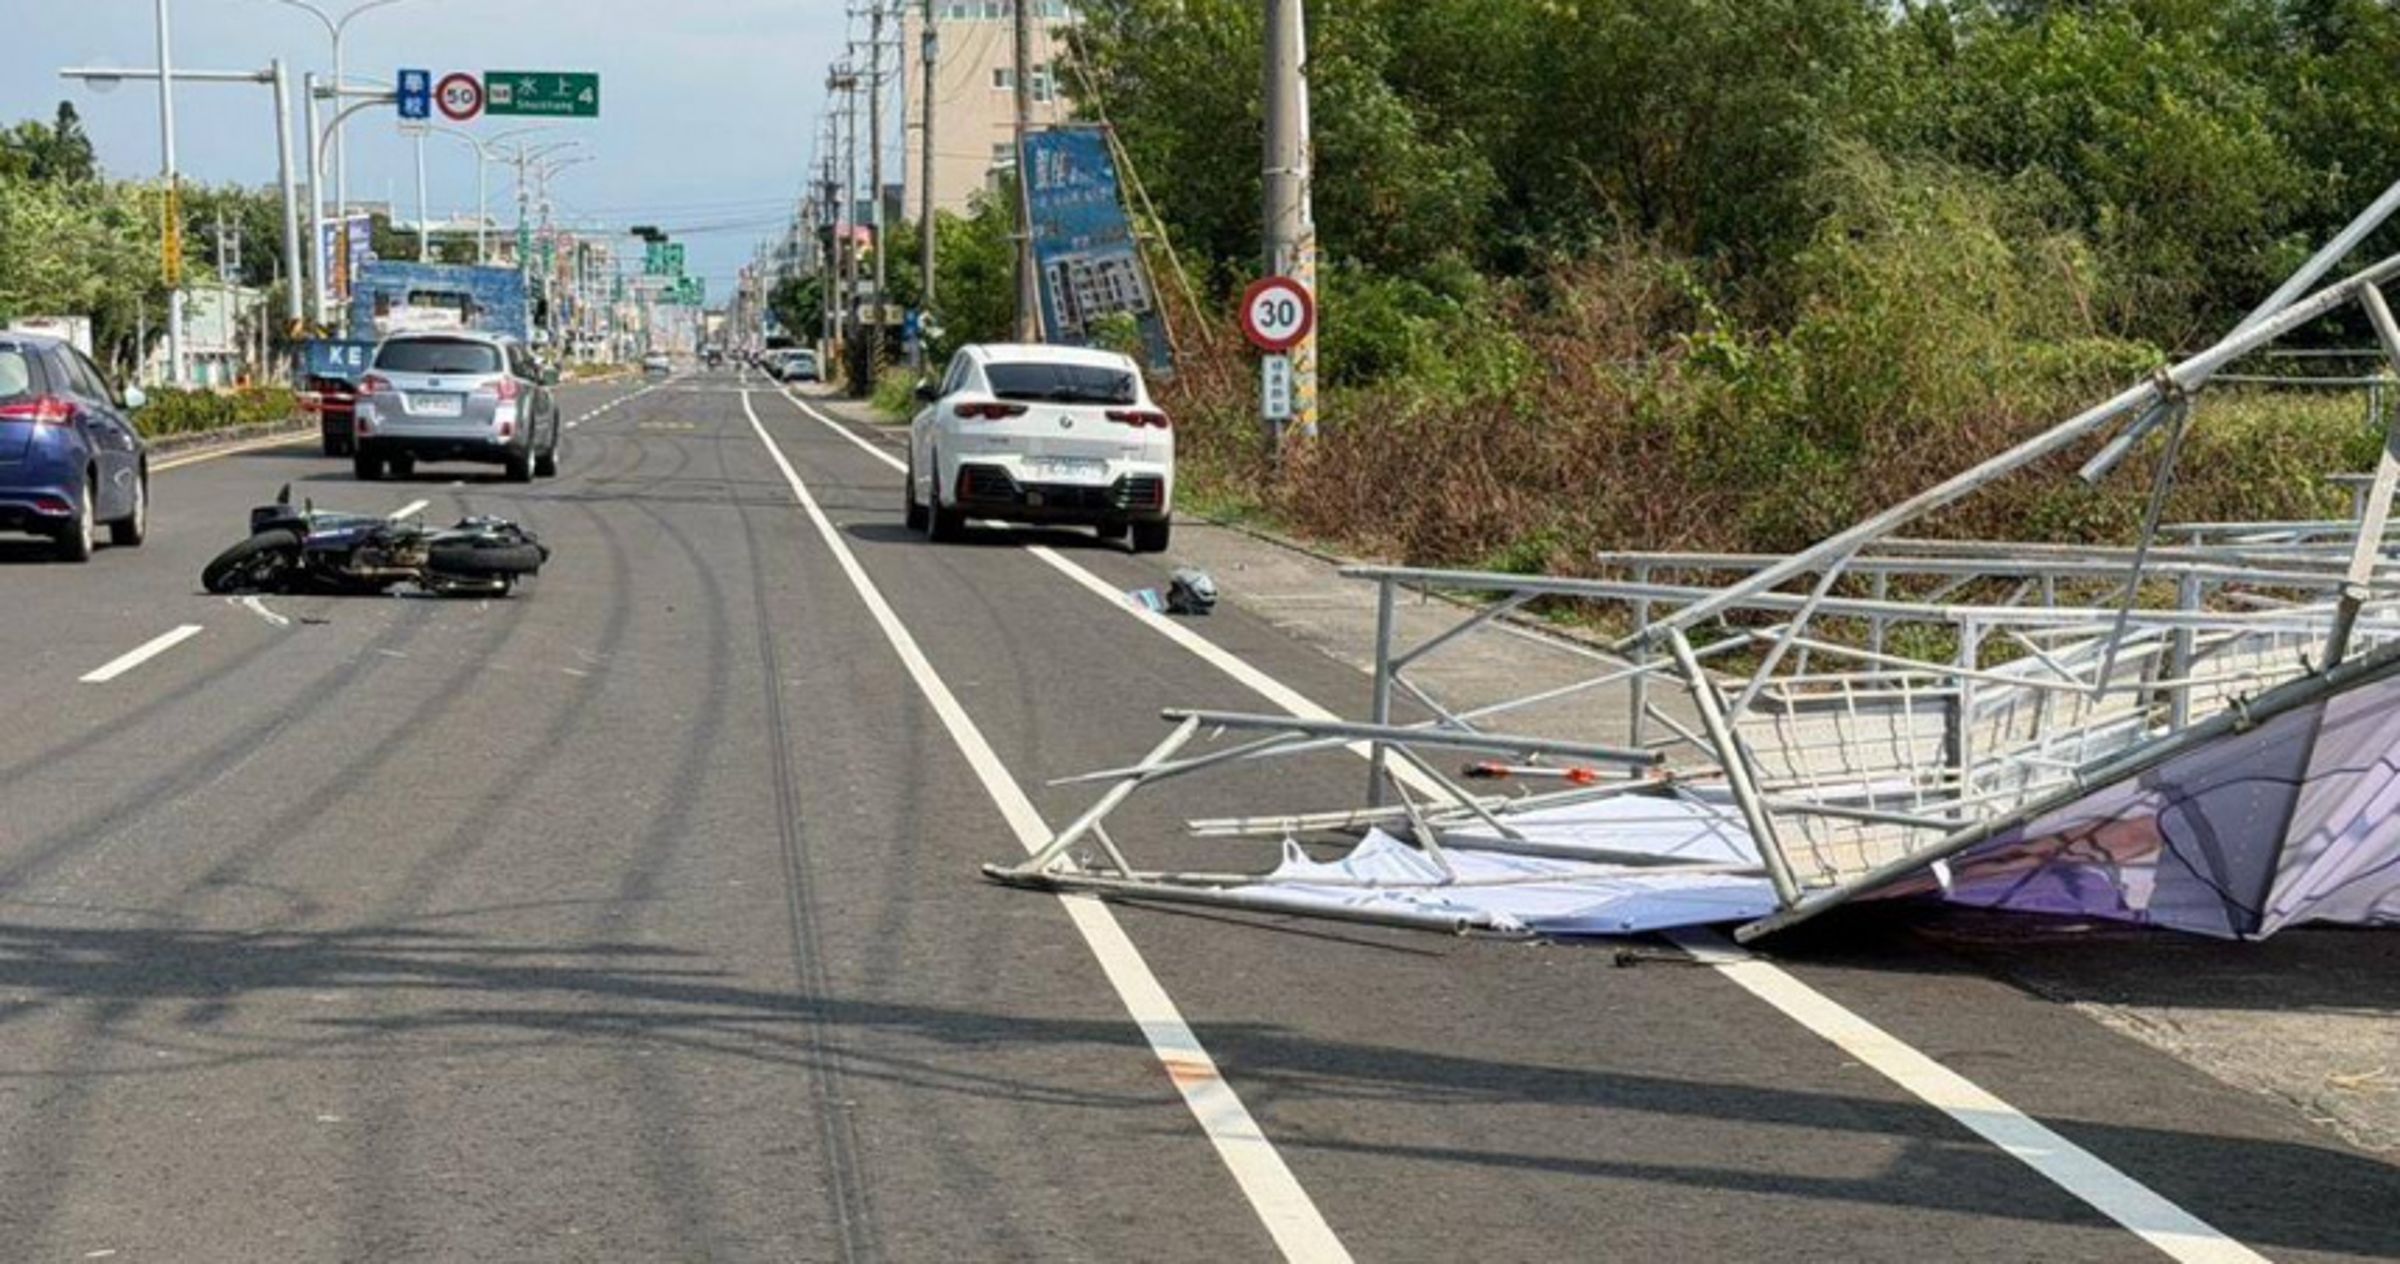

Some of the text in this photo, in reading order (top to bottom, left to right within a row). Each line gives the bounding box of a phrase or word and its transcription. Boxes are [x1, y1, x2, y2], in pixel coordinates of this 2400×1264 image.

[446, 88, 474, 105] 50
[517, 77, 573, 97] 水上
[577, 85, 594, 105] 4
[1259, 299, 1295, 328] 30
[329, 345, 376, 365] KE
